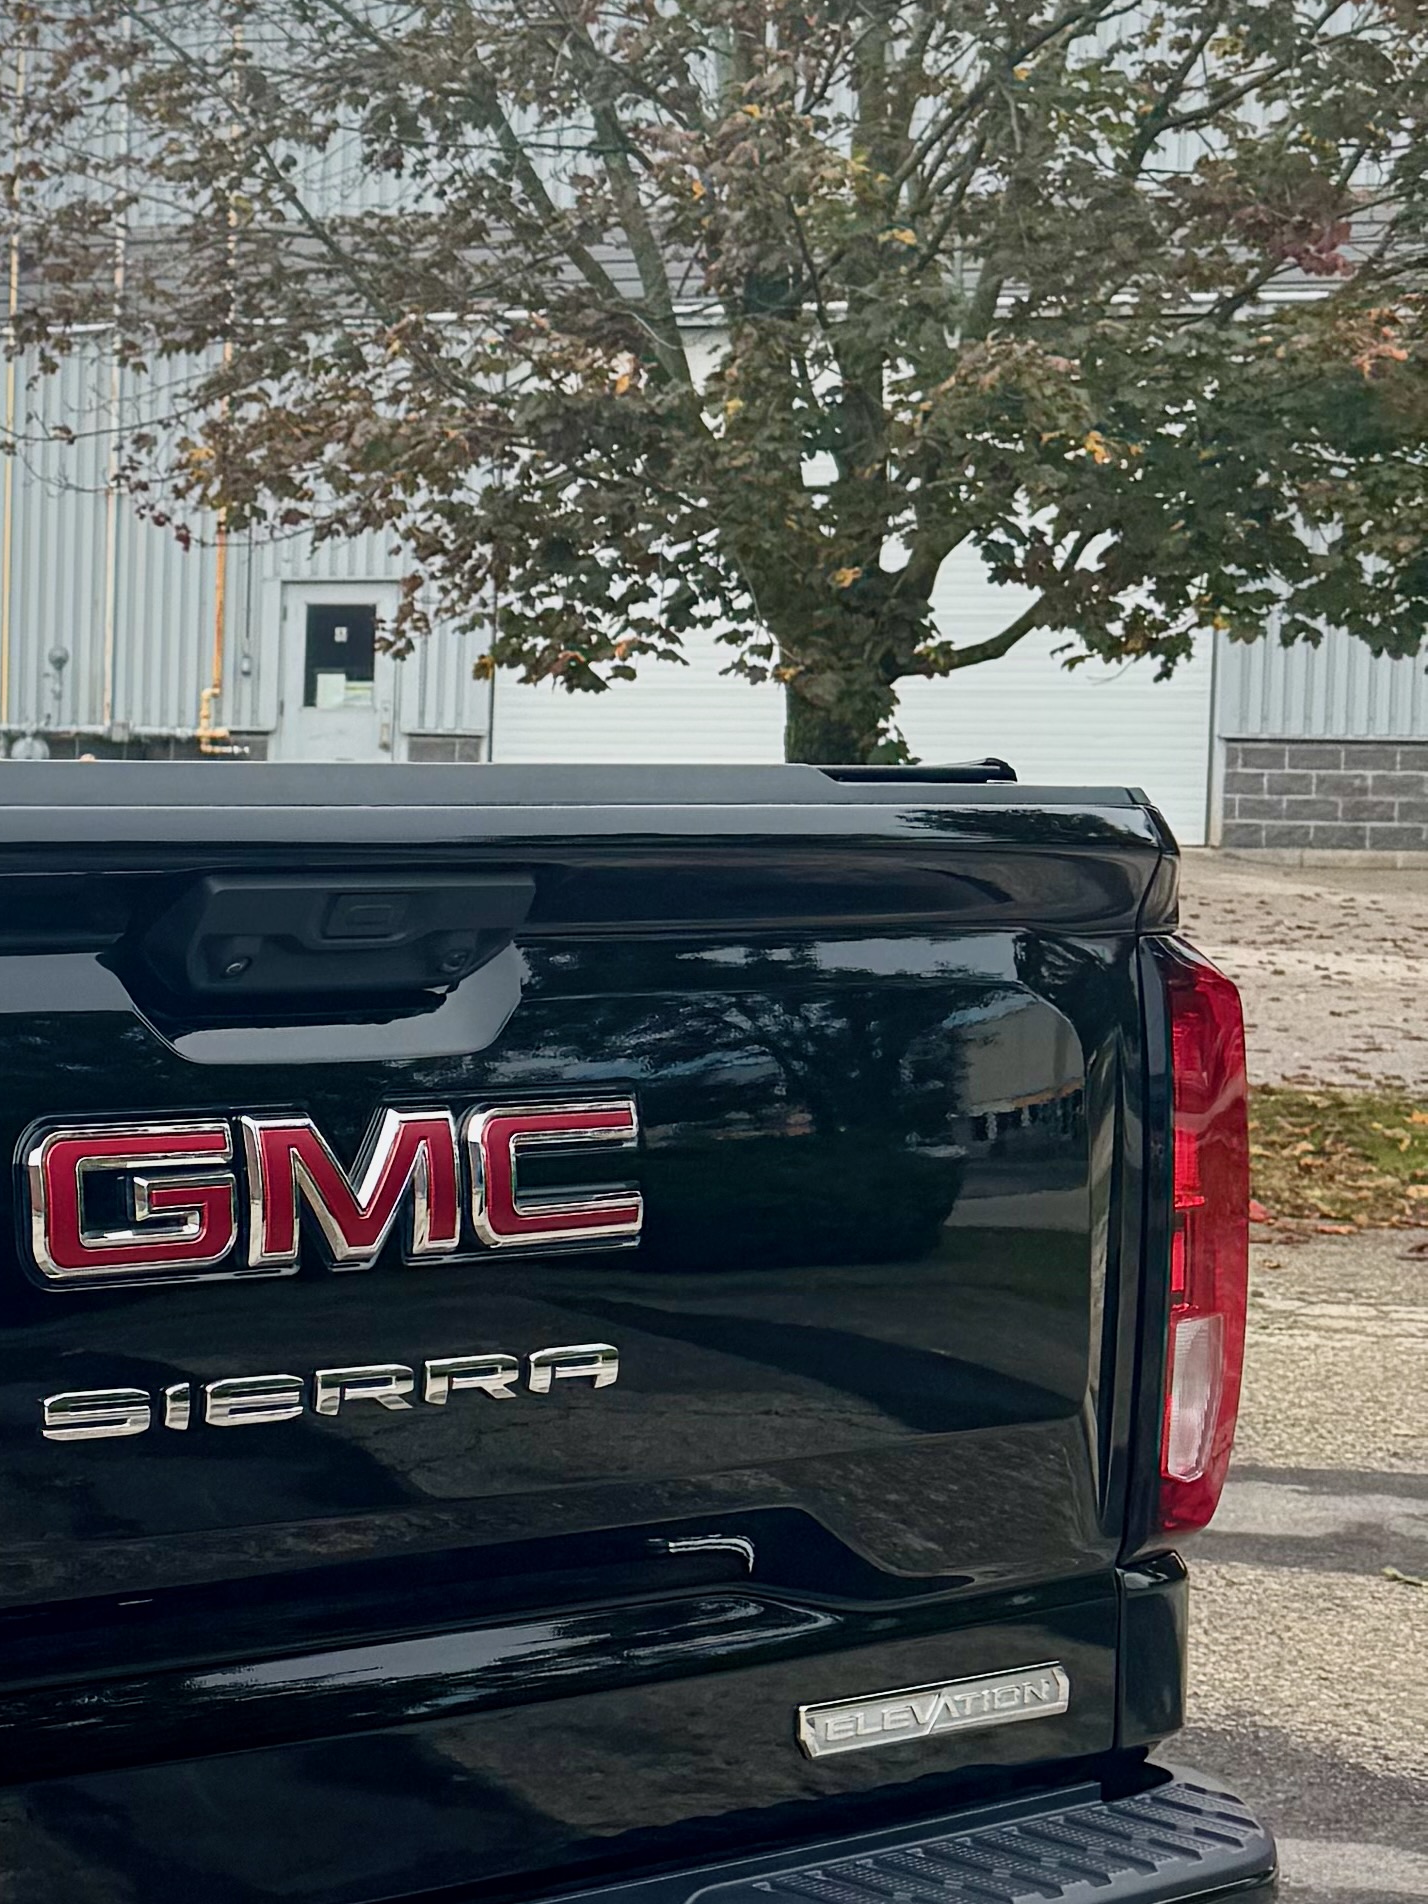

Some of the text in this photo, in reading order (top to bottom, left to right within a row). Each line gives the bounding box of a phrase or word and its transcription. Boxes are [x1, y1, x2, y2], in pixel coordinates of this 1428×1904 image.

[26, 1095, 643, 1279] GMC
[41, 1342, 620, 1442] SIERRA
[825, 1678, 1051, 1742] ELEVATION
